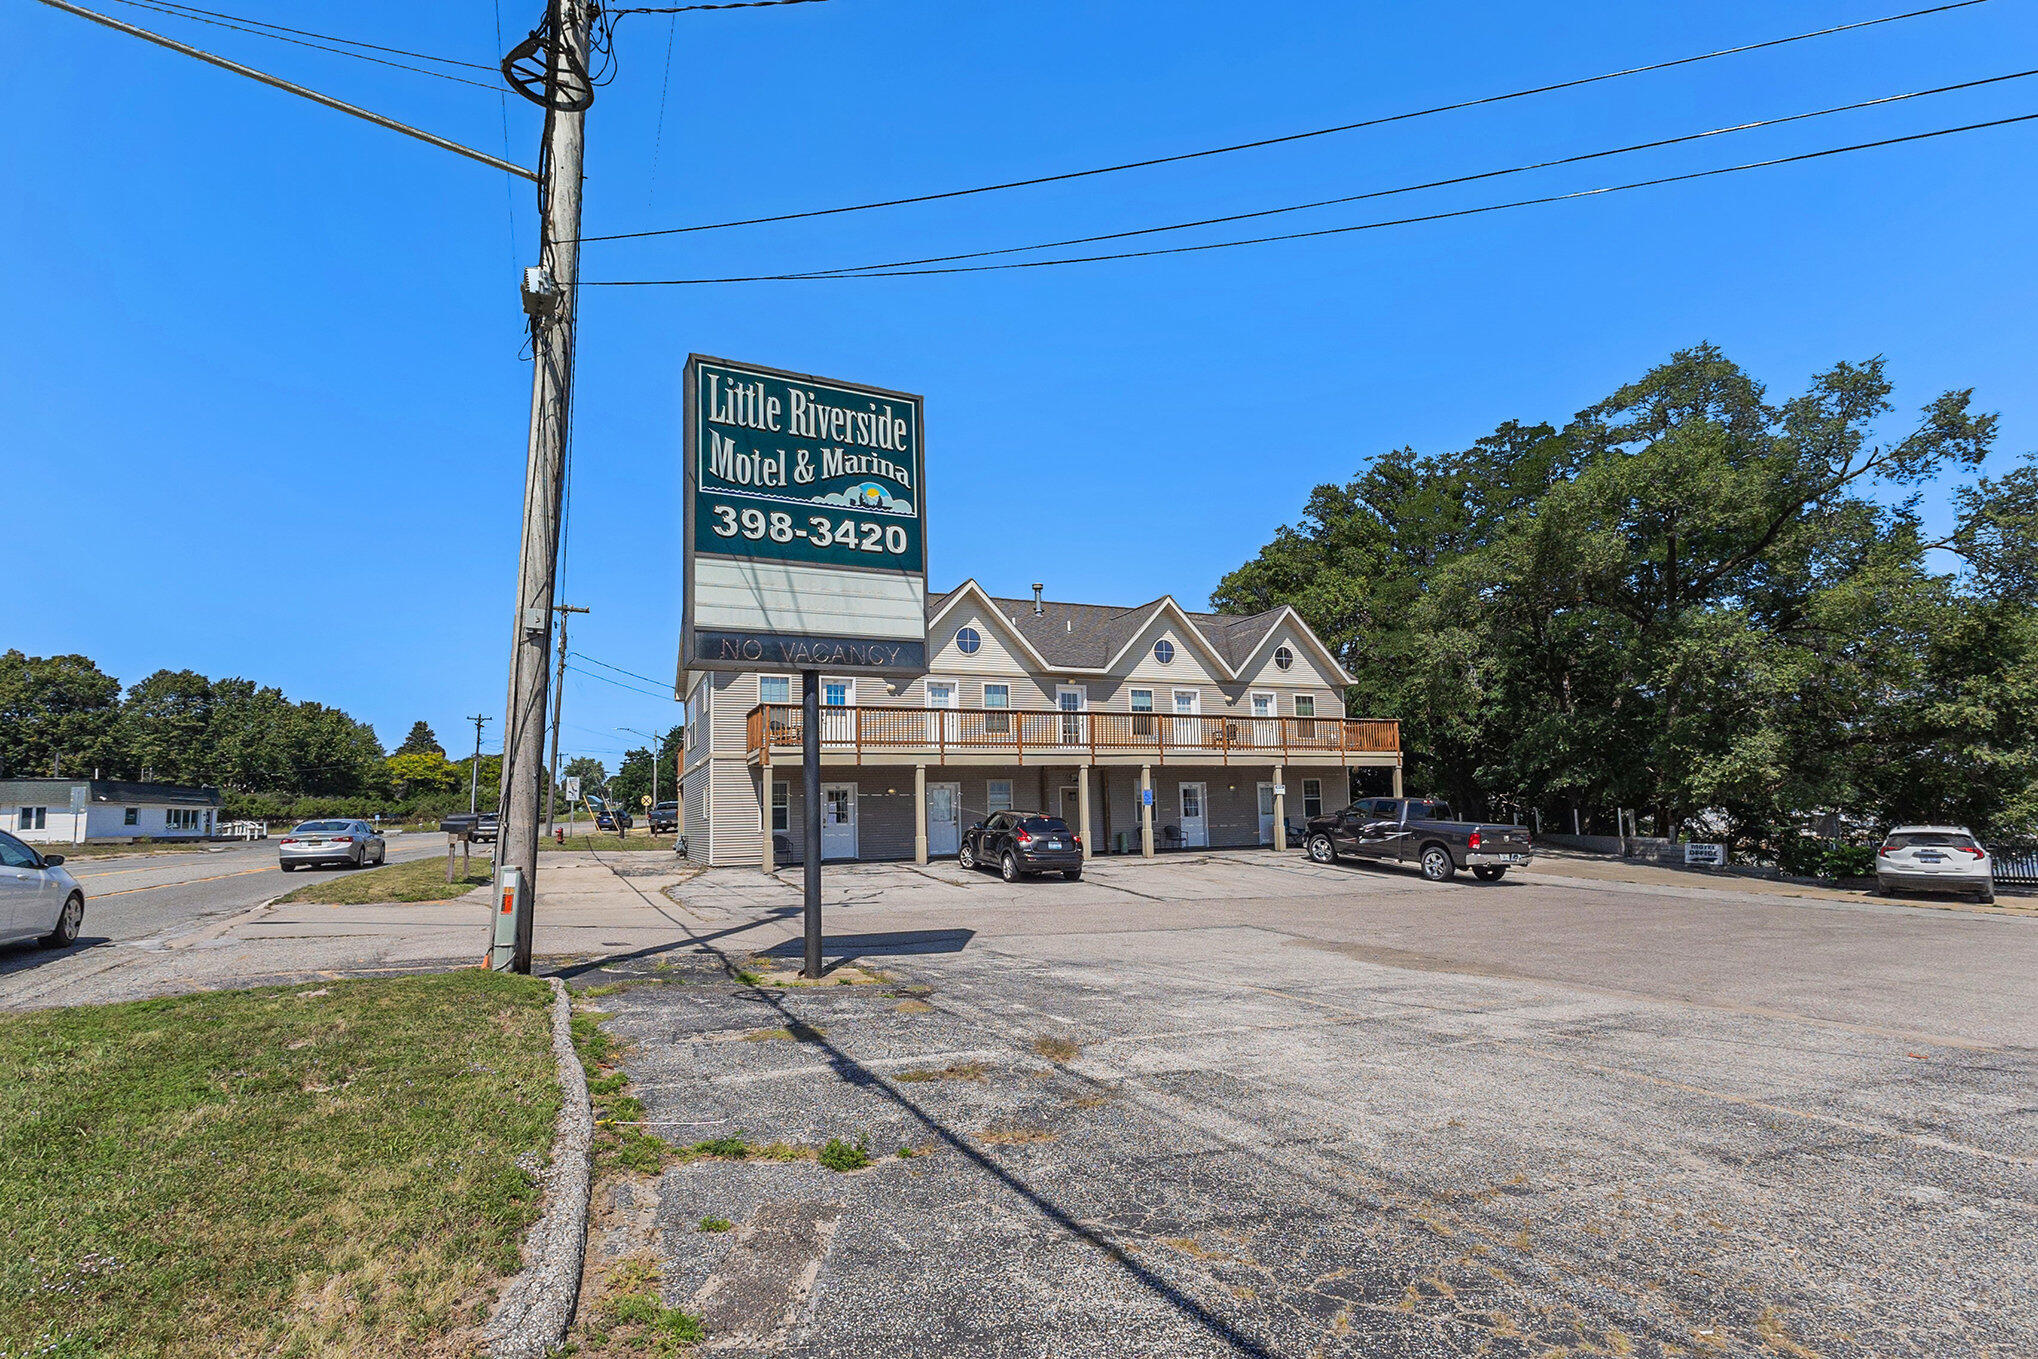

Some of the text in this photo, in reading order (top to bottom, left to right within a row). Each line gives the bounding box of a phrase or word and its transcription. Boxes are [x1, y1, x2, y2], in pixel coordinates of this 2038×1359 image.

[707, 373, 907, 451] Little Riverside
[708, 427, 911, 489] Motel & Marina
[712, 505, 908, 554] 398-3420
[720, 638, 901, 666] NO VACANCY
